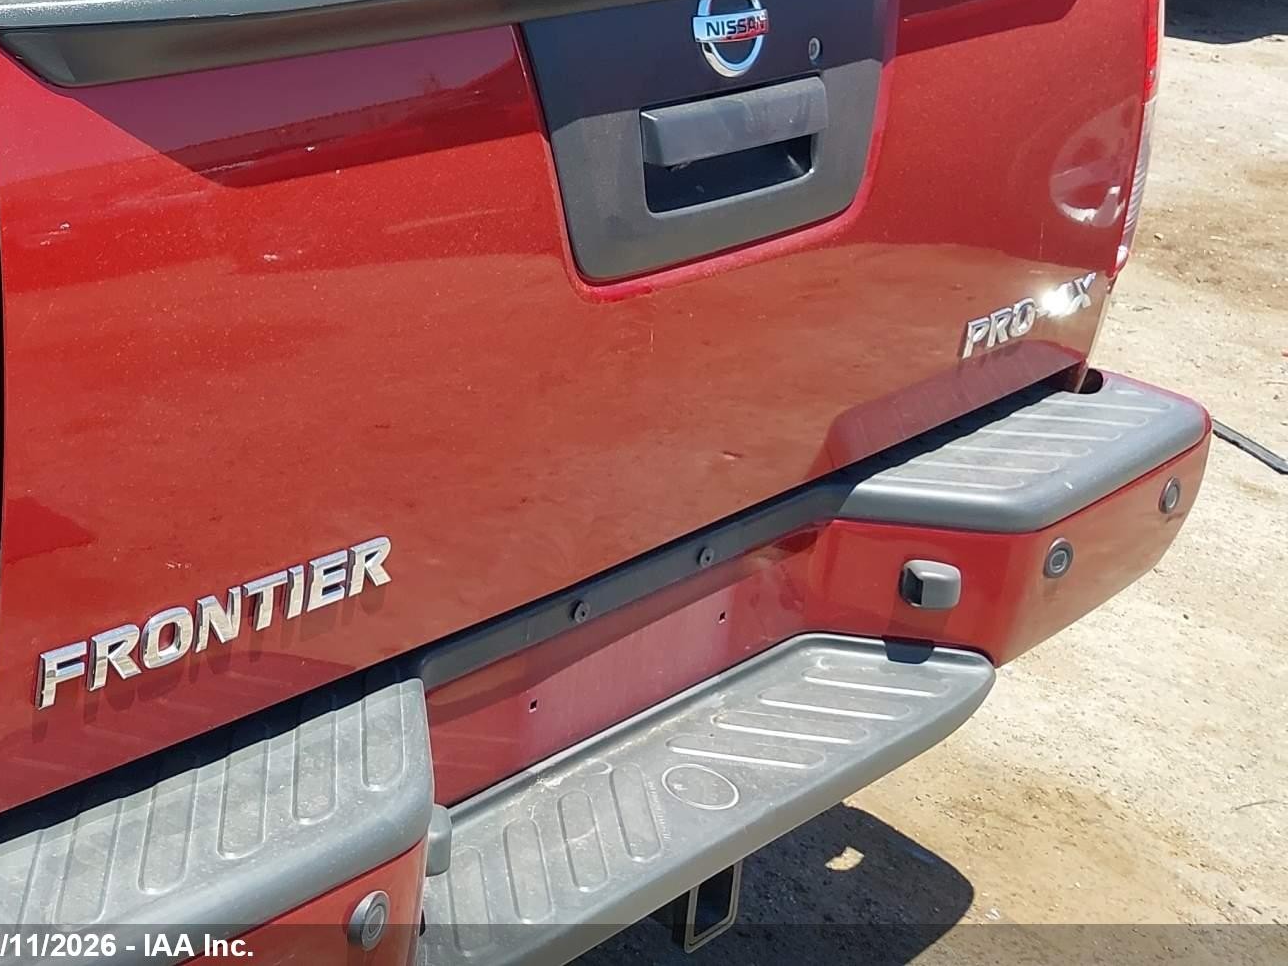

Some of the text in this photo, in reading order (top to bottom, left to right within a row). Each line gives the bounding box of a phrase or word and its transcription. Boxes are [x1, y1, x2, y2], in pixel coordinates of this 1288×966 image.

[705, 15, 764, 37] NISSAN
[962, 271, 1097, 360] PRO-X
[34, 536, 392, 711] FRONTIER
